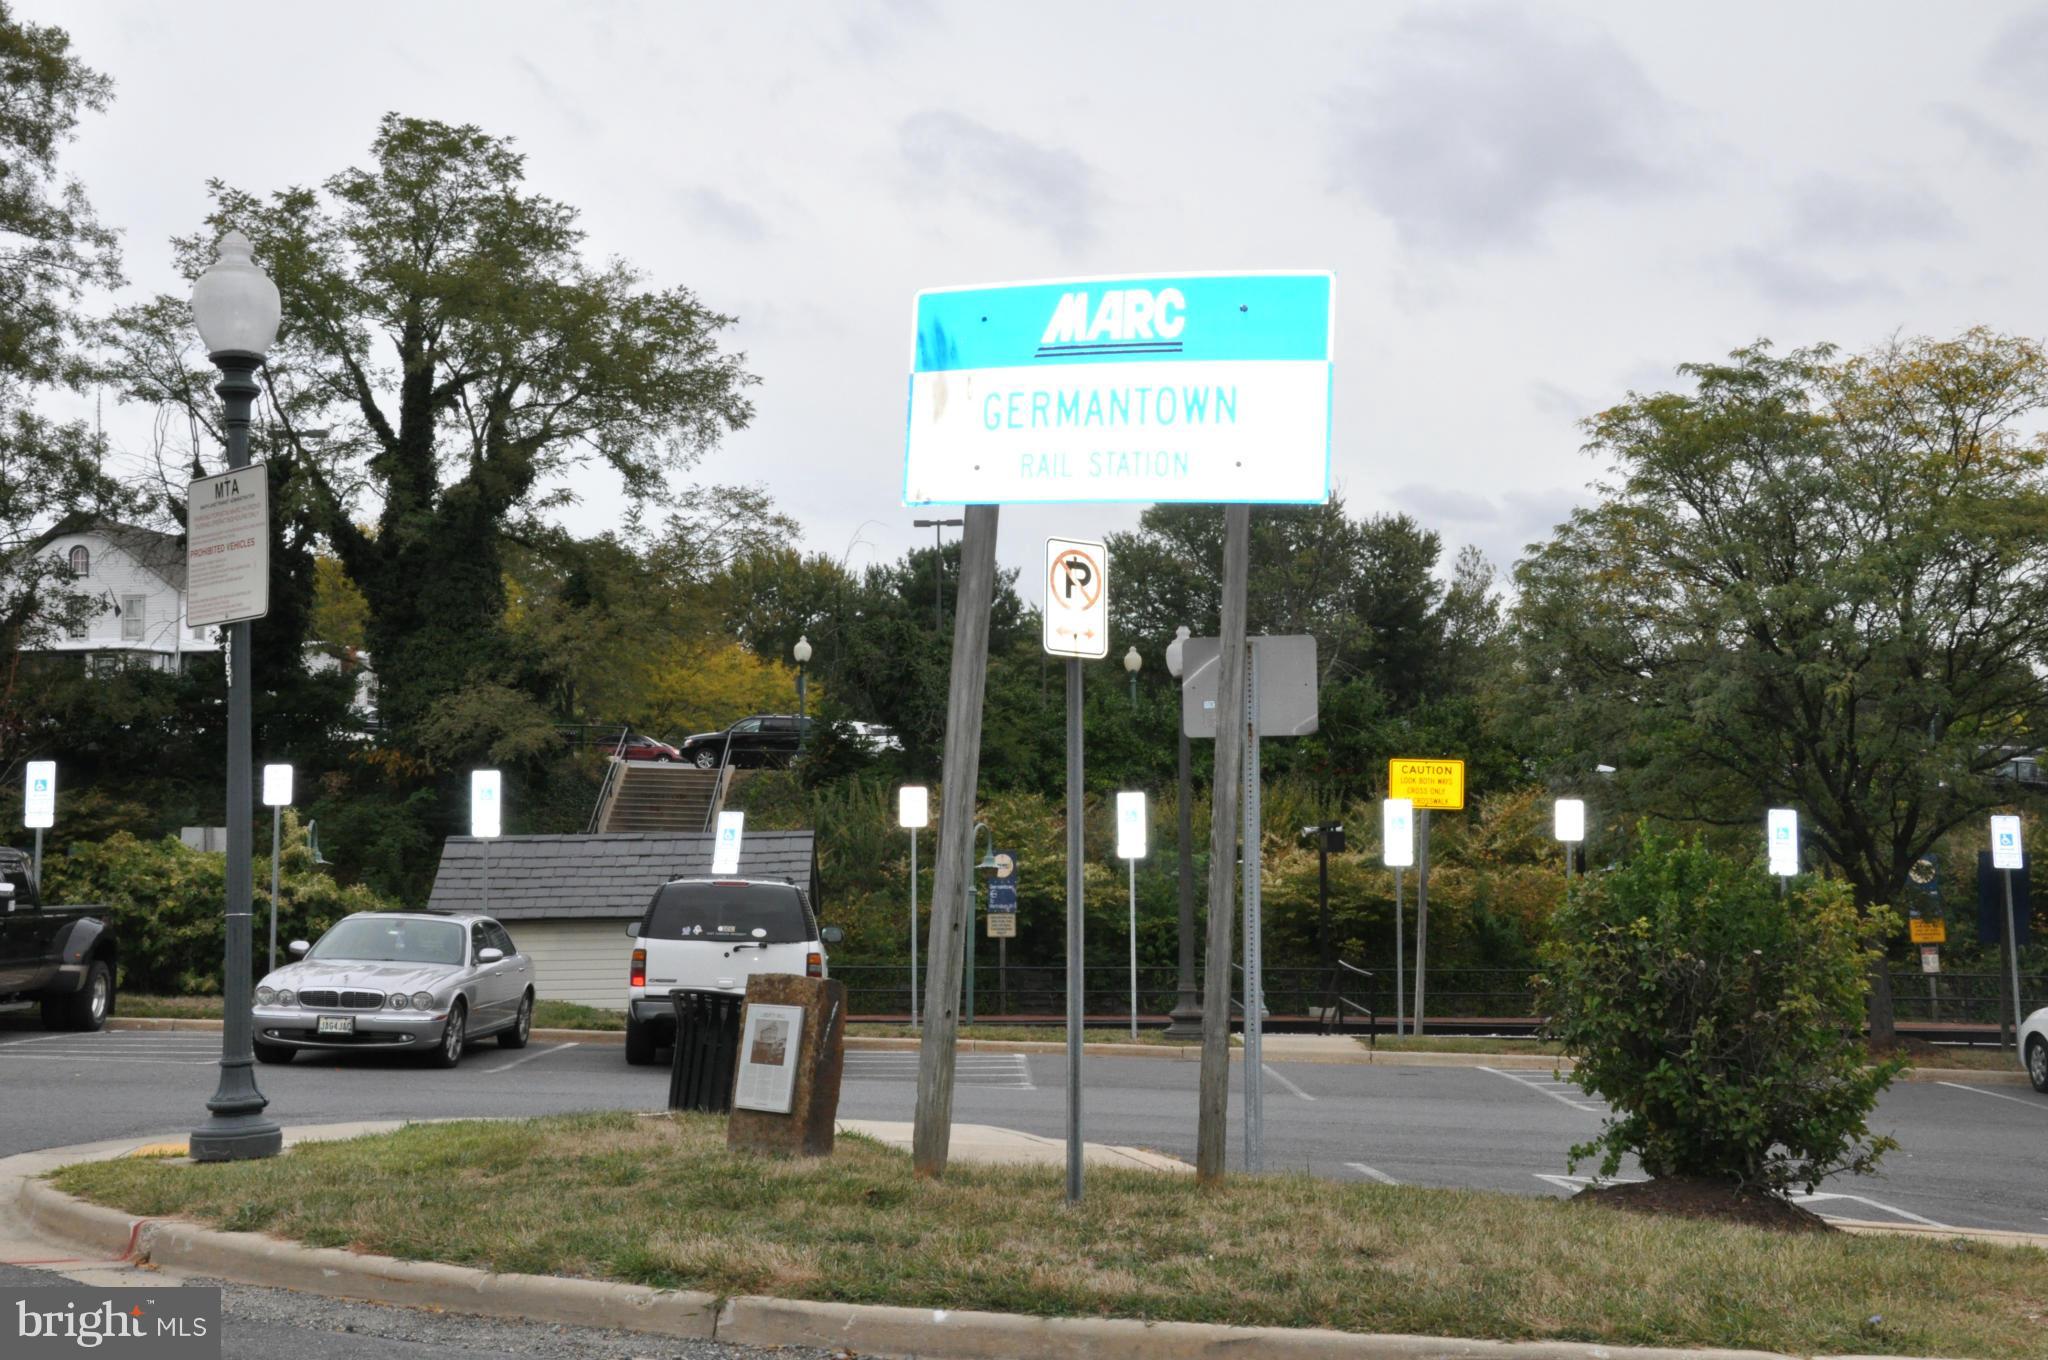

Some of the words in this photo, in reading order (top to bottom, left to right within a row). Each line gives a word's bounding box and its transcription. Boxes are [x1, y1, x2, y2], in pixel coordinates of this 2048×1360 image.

[1041, 287, 1186, 343] MARC
[983, 385, 1238, 431] GERMANTOWN
[1021, 452, 1073, 479] RAIL
[1088, 450, 1189, 479] STATION
[215, 479, 239, 499] MTA
[190, 543, 225, 558] PROHIBITED
[1401, 765, 1453, 775] CAUTION
